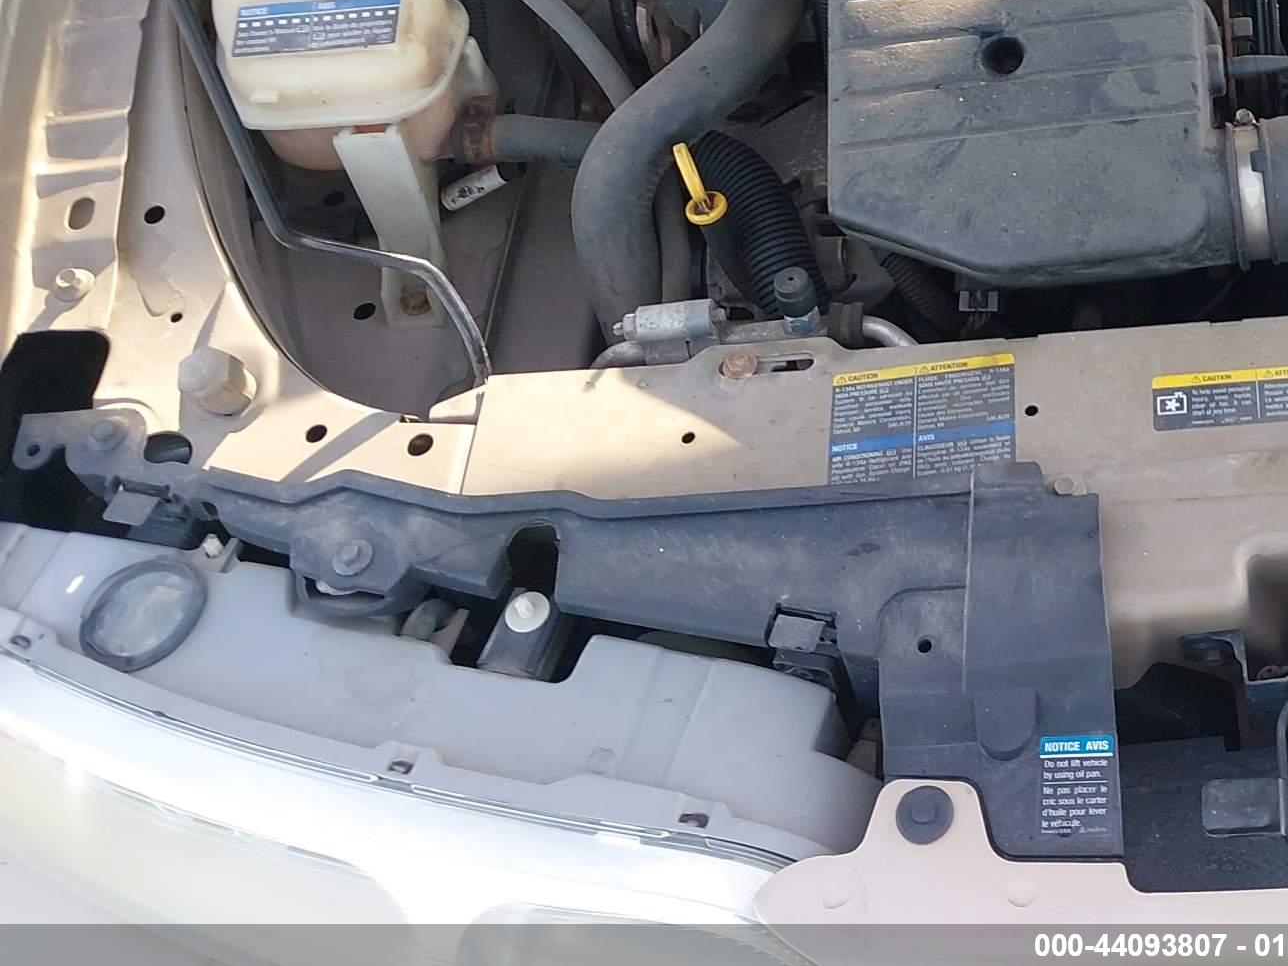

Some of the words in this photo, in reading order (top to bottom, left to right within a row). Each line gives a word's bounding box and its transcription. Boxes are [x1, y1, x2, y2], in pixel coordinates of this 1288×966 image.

[930, 361, 968, 372] ATTENTION
[847, 372, 878, 382] CAUTION
[1202, 374, 1232, 382] CAUTION
[918, 434, 935, 442] AVIS
[832, 443, 858, 453] NOTICE
[1044, 741, 1080, 752] NOTICE
[1086, 740, 1109, 751] AVIS
[1044, 760, 1054, 768] Do
[1071, 759, 1080, 767] lift
[1083, 759, 1108, 767] vehicle
[1043, 771, 1053, 780] by
[1054, 770, 1074, 780] using
[1076, 770, 1085, 778] oil
[1086, 770, 1102, 779] pan.
[1043, 786, 1053, 794] Ne
[1057, 787, 1071, 795] pas
[1074, 785, 1096, 794] placer
[1100, 785, 1108, 793] le
[1058, 797, 1075, 805] sous
[1085, 796, 1107, 804] carter
[1042, 808, 1067, 817] d'huile
[1069, 808, 1086, 817] pour
[1041, 819, 1048, 827] le
